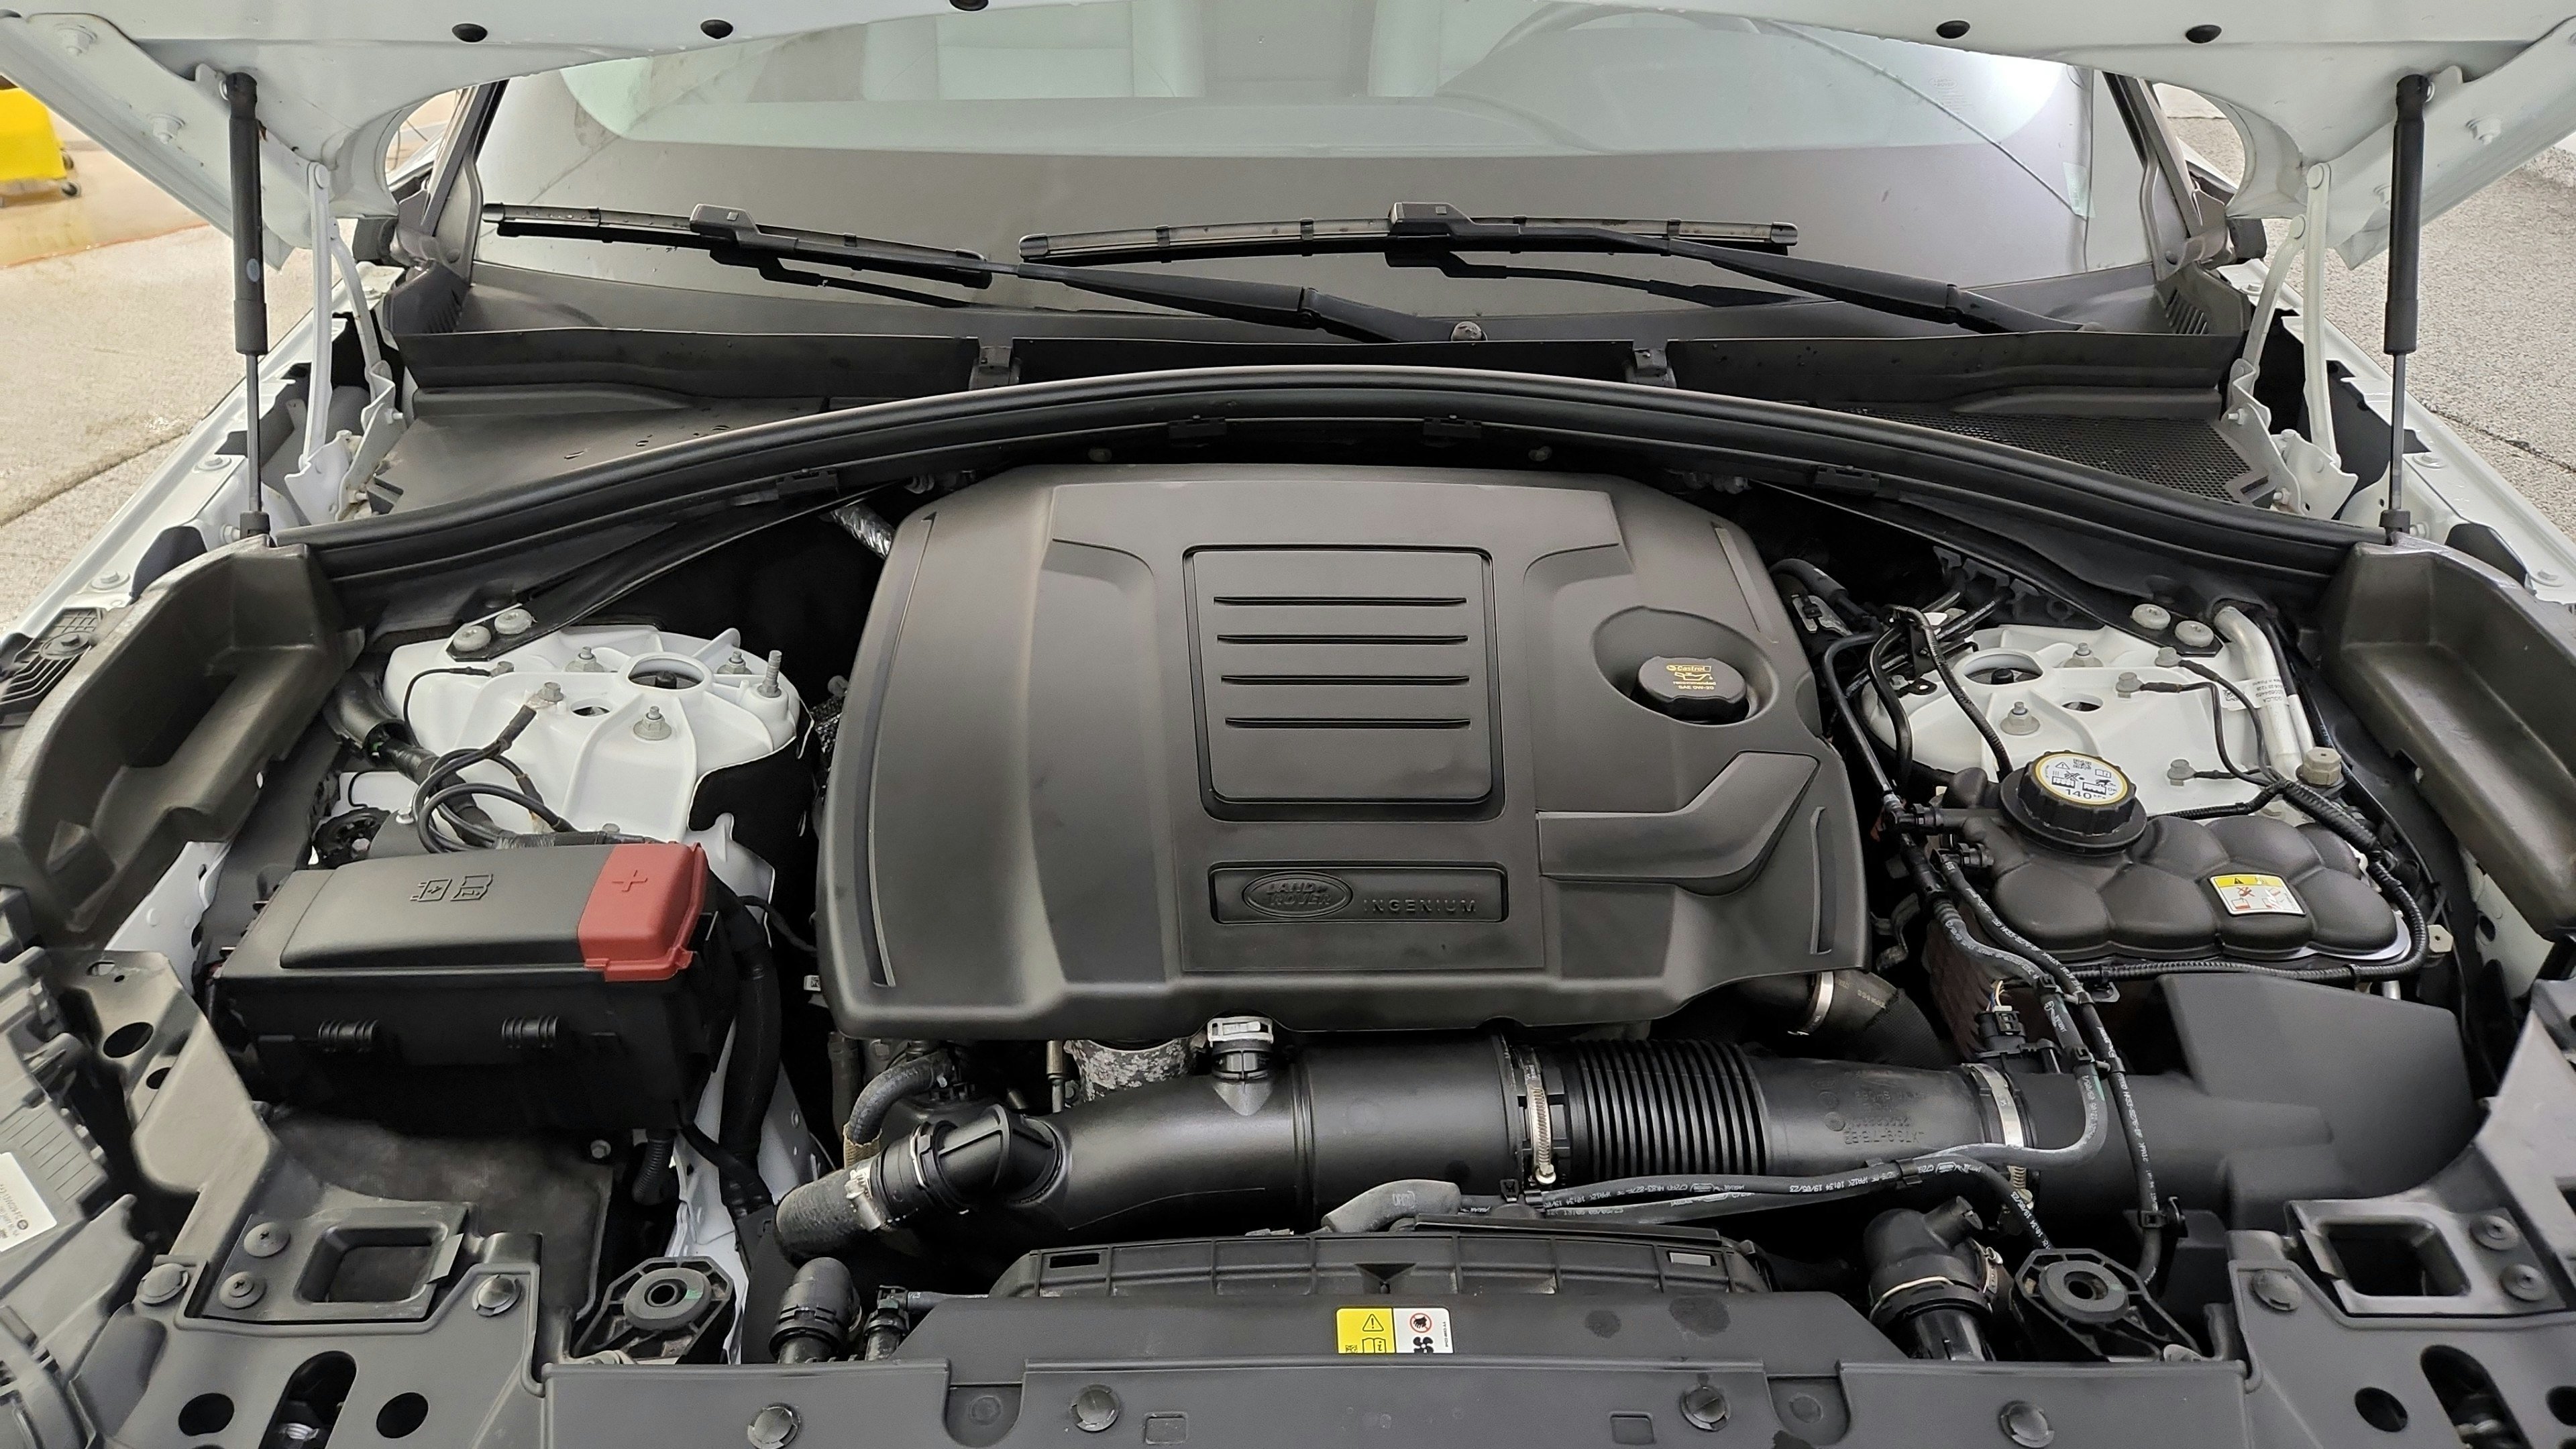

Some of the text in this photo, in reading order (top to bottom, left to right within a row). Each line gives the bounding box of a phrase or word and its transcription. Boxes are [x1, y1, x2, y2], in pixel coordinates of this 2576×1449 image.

[2065, 789, 2092, 799] 140
[1266, 881, 1316, 894] LAND
[1269, 893, 1332, 906] ROVER
[1364, 898, 1477, 913] INGENIUM
[1825, 1181, 1845, 1190] 10:34
